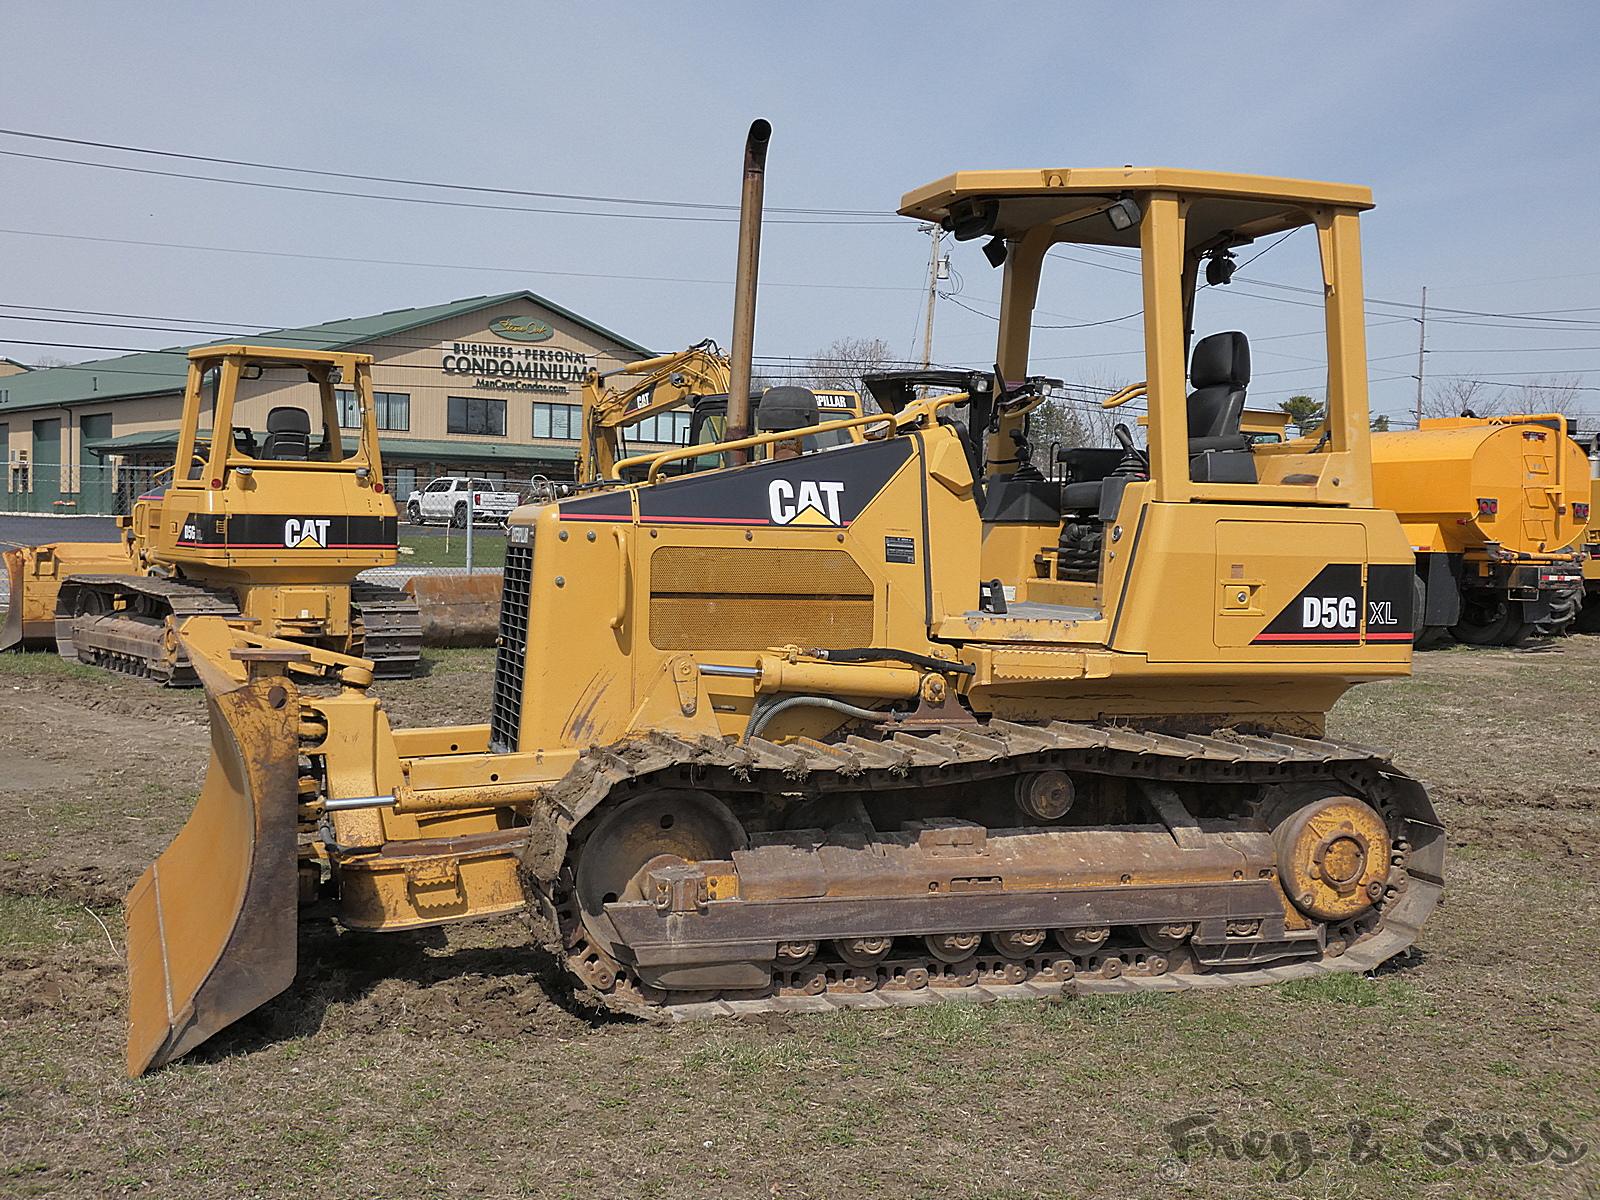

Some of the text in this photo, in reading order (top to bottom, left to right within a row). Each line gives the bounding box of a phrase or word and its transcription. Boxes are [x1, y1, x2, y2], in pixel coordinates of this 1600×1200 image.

[453, 343, 588, 364] BUSINESS PERSONAL
[475, 378, 567, 393] ManCaveCondos.com
[636, 392, 650, 409] CAT
[768, 479, 845, 526] CAT
[284, 518, 331, 548] CAT
[1302, 596, 1398, 629] D5G XL
